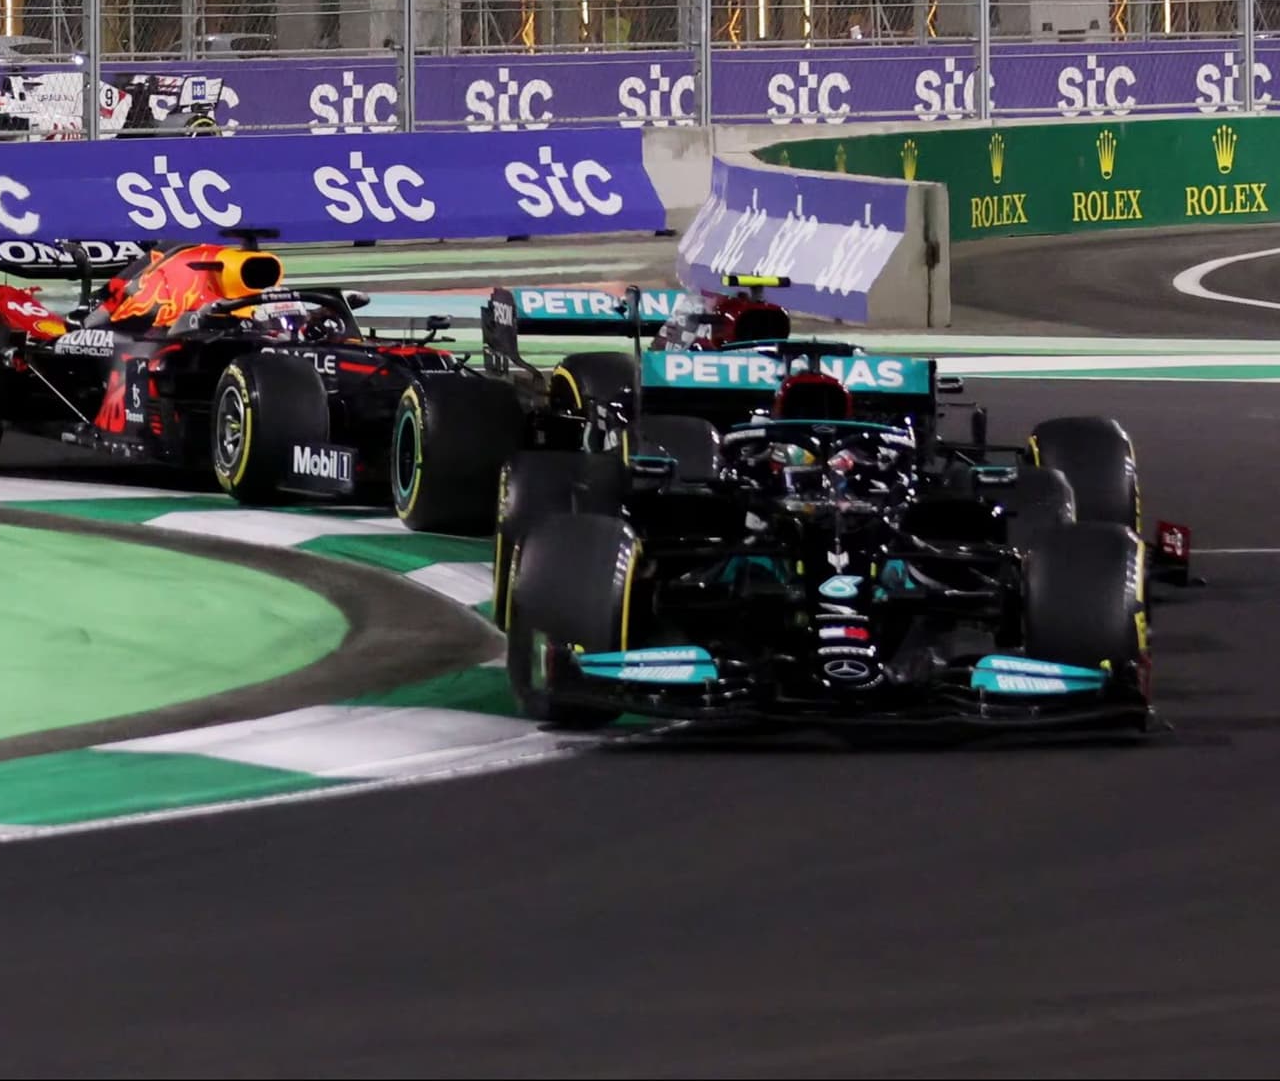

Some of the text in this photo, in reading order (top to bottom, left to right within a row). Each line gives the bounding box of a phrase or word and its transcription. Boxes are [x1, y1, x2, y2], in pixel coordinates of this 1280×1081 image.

[104, 88, 114, 107] 9
[309, 71, 398, 134] stc
[465, 68, 553, 132] stc
[767, 62, 851, 125] stc
[914, 57, 995, 121] stc
[1058, 55, 1136, 116] stc
[116, 155, 242, 231] stc
[313, 151, 436, 224] stc
[505, 146, 623, 218] stc
[971, 193, 1028, 229] ROLEX
[1072, 189, 1143, 223] ROLEX
[1185, 183, 1270, 217] ROLEX
[58, 329, 115, 349] HONDA
[493, 301, 513, 327] PSON
[293, 446, 338, 477] Mobil
